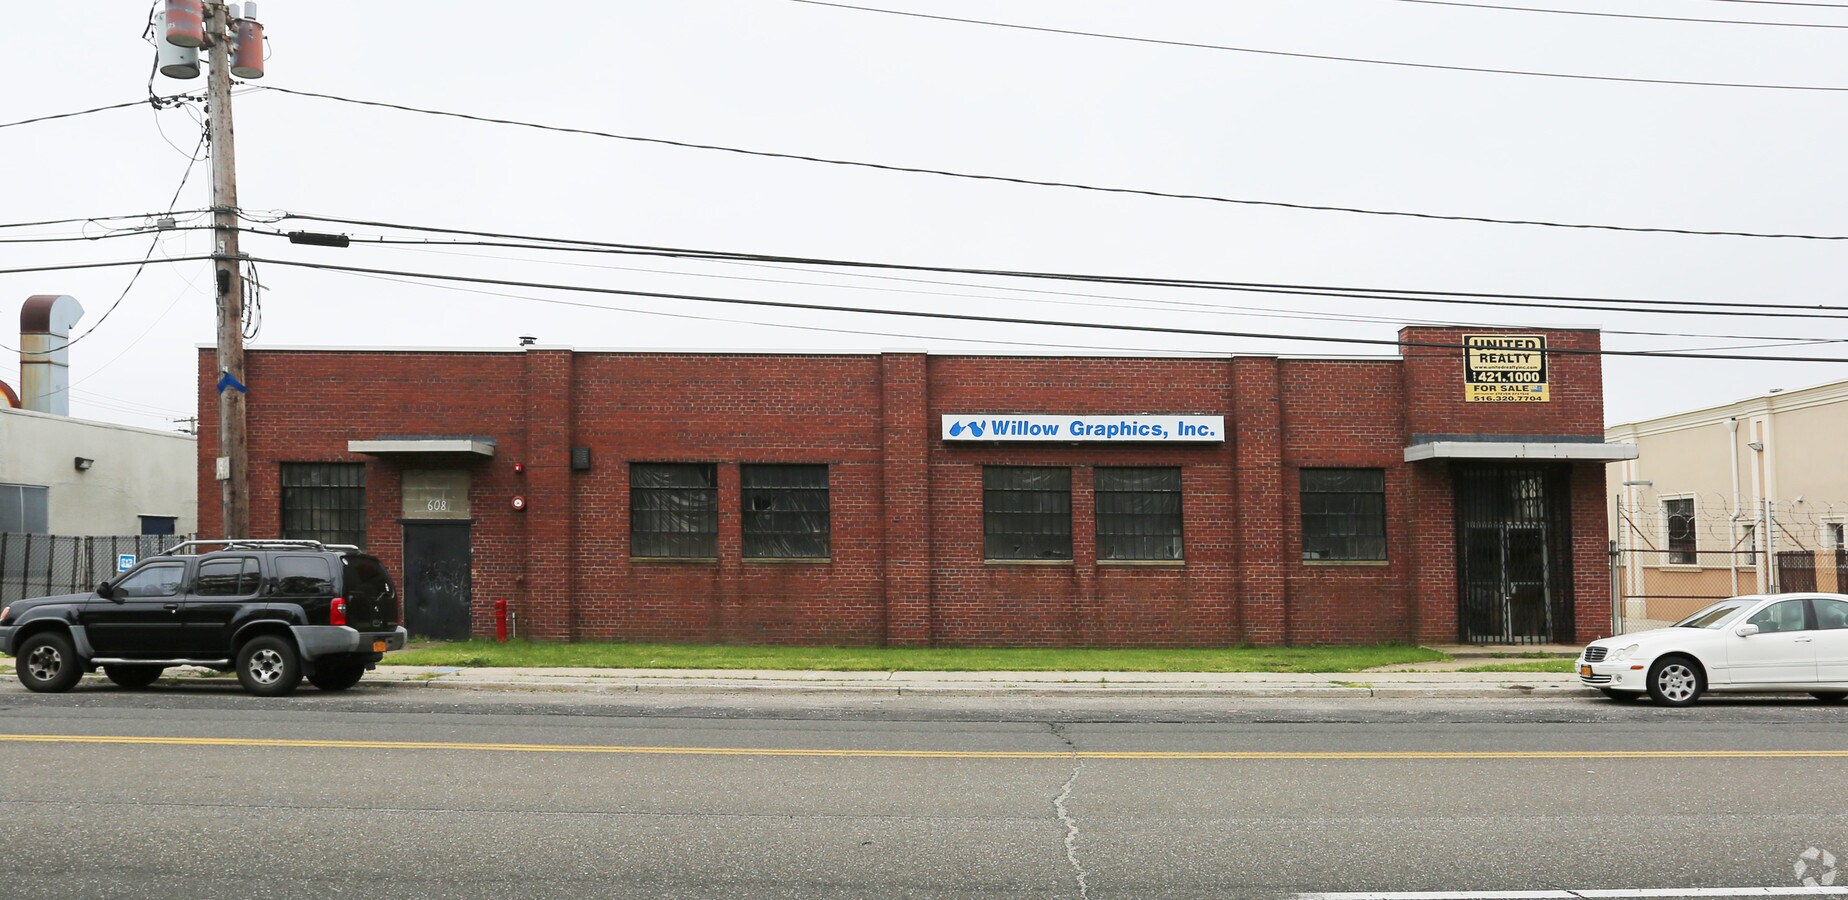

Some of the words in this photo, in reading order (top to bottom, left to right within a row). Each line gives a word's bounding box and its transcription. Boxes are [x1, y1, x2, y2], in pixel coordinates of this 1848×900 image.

[1473, 339, 1536, 351] UNITED
[1479, 353, 1531, 363] REALTY
[991, 419, 1060, 436] Willow
[1069, 420, 1169, 439] Graphics,
[1178, 421, 1215, 436] Inc.
[427, 499, 447, 511] 608
